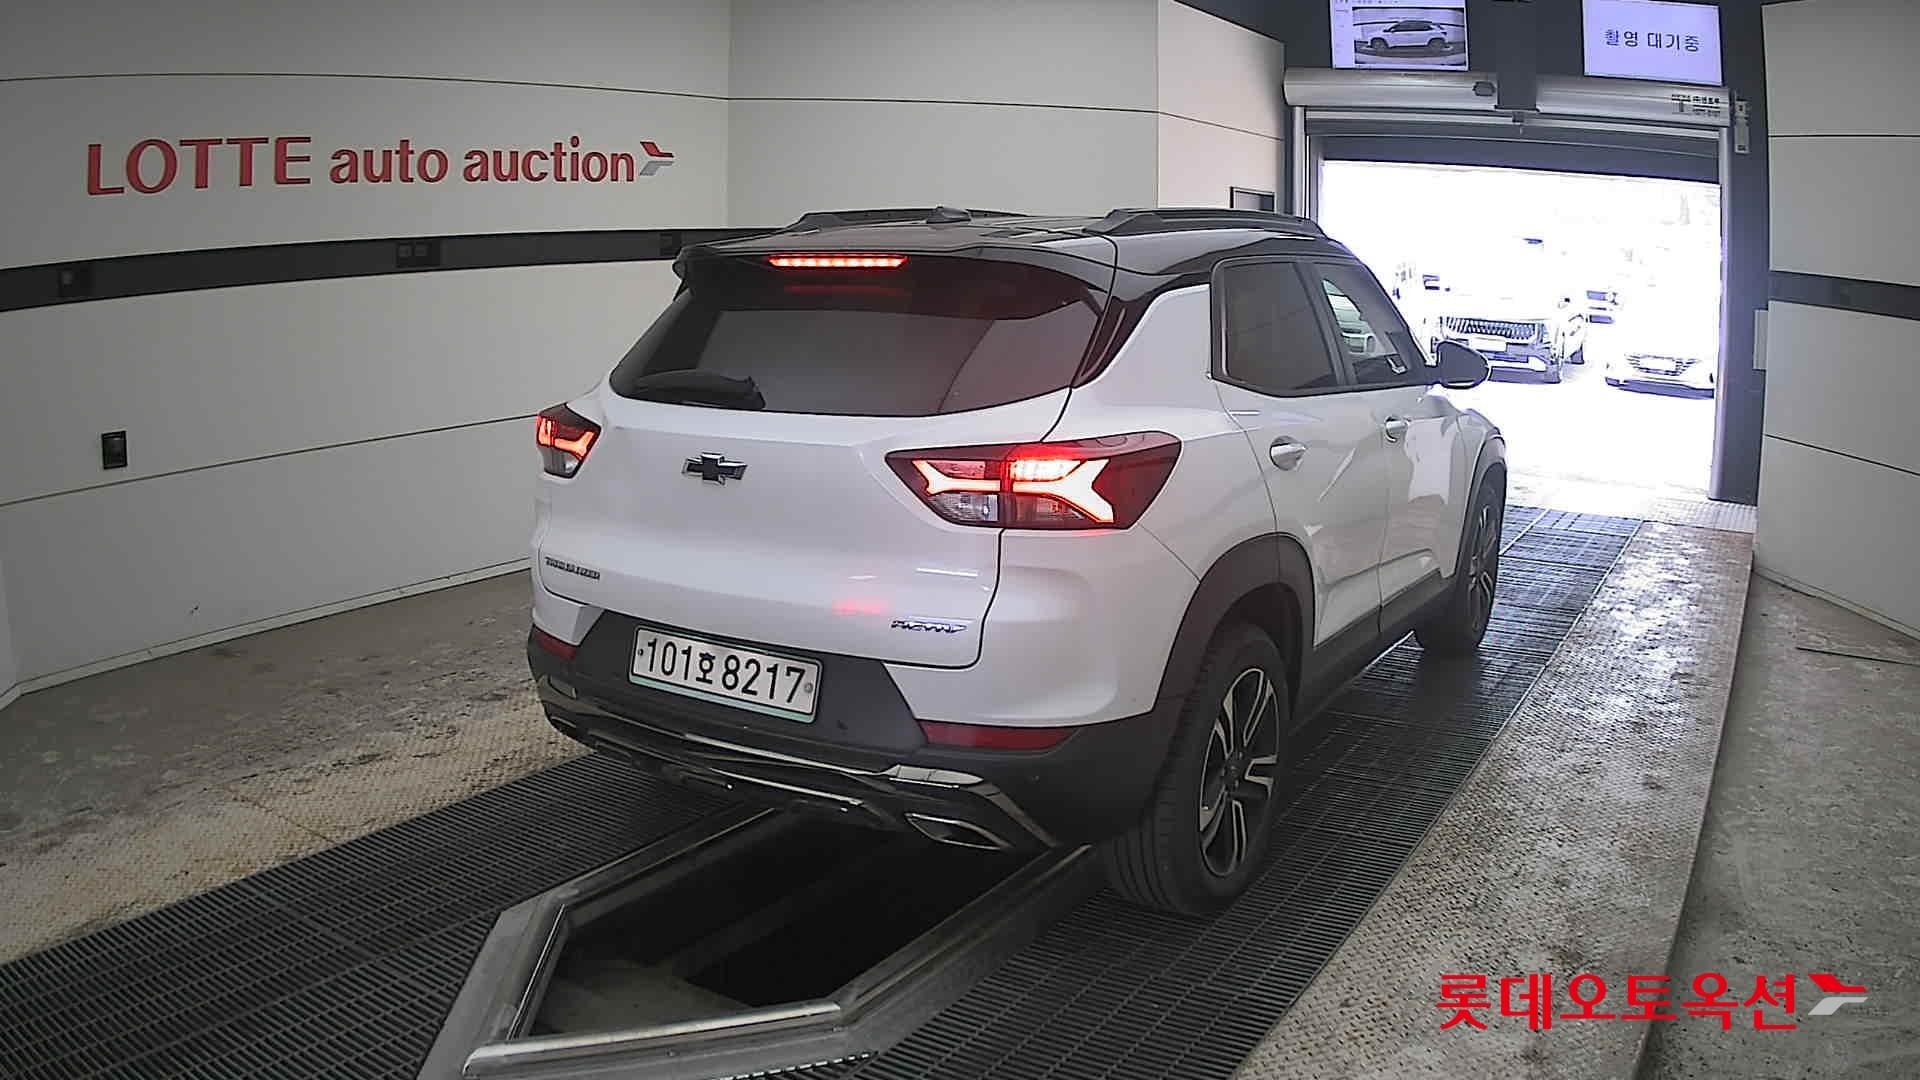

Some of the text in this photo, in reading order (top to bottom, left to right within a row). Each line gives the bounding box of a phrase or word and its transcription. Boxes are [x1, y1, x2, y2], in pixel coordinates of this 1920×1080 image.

[1647, 32, 1701, 53] 대기중
[88, 135, 636, 195] LOTTE auto auction
